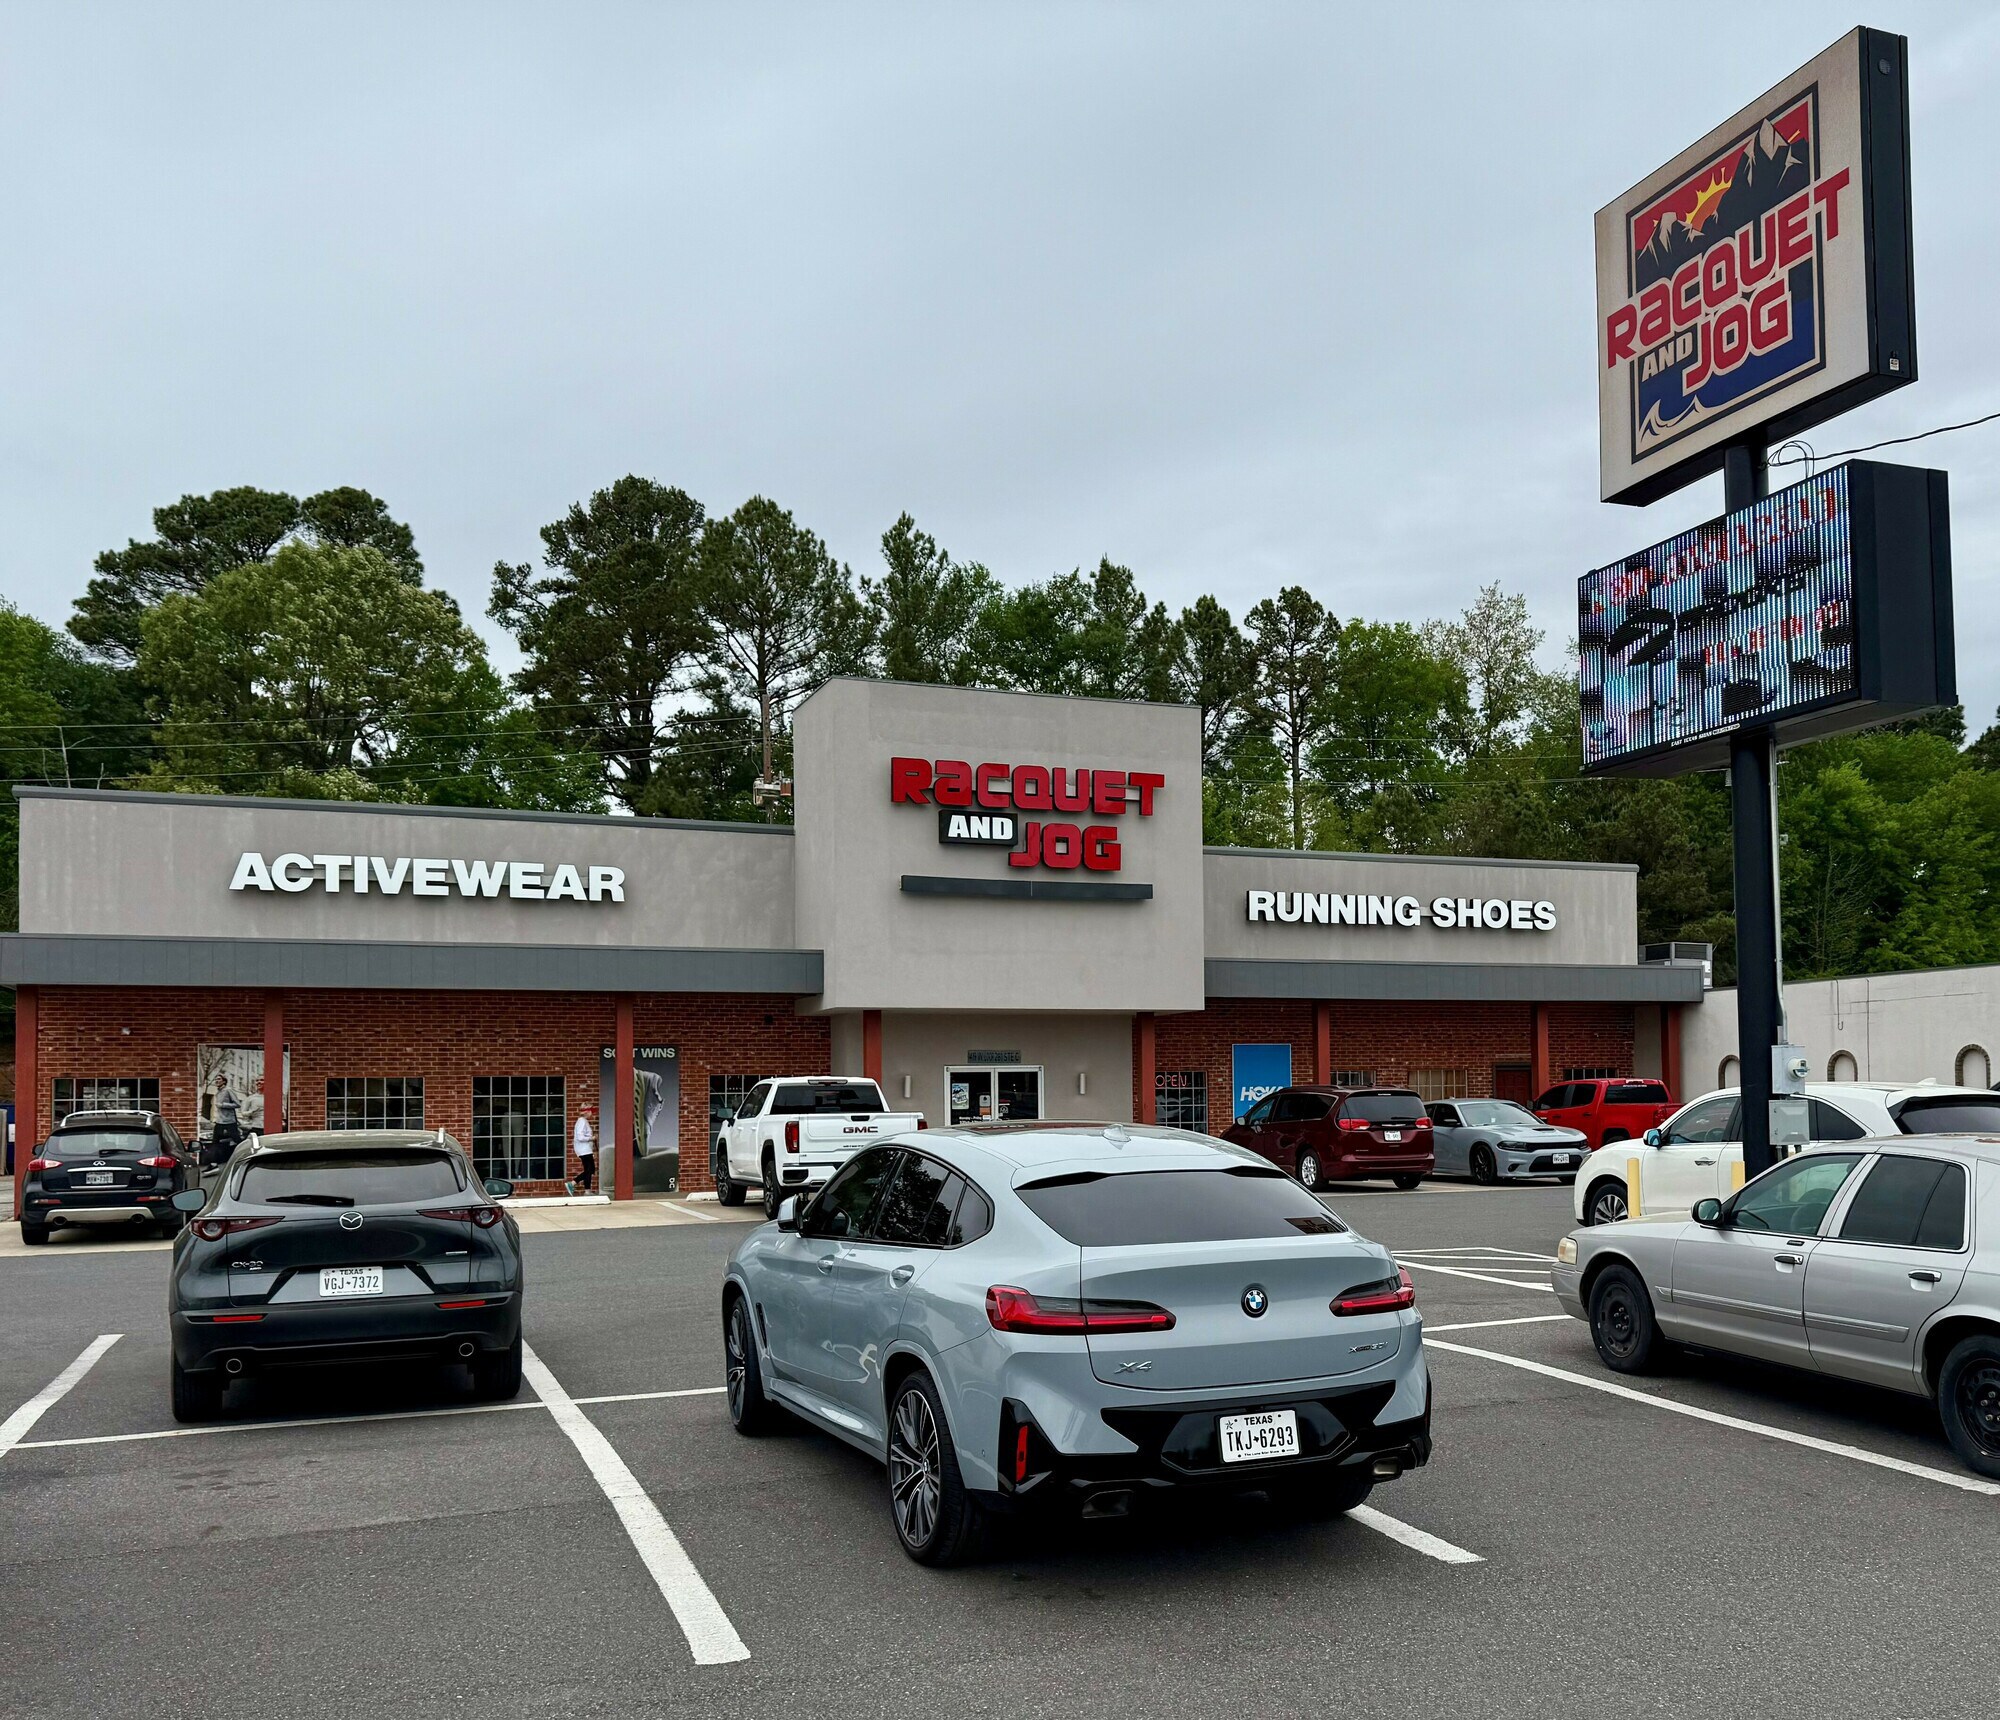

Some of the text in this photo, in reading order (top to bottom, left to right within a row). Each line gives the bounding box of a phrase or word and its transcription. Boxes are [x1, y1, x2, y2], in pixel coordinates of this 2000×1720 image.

[1641, 278, 1789, 389] AND JOG
[948, 815, 1121, 871] AND JOG
[229, 852, 625, 902] ACTIVEWEAR
[1247, 890, 1557, 931] RUNNING SHOES
[640, 1047, 676, 1058] WINS
[1155, 1075, 1187, 1087] OPEN
[339, 1268, 364, 1276] TEXAS
[1114, 1361, 1152, 1374] X4
[1244, 1415, 1273, 1426] TEXAS
